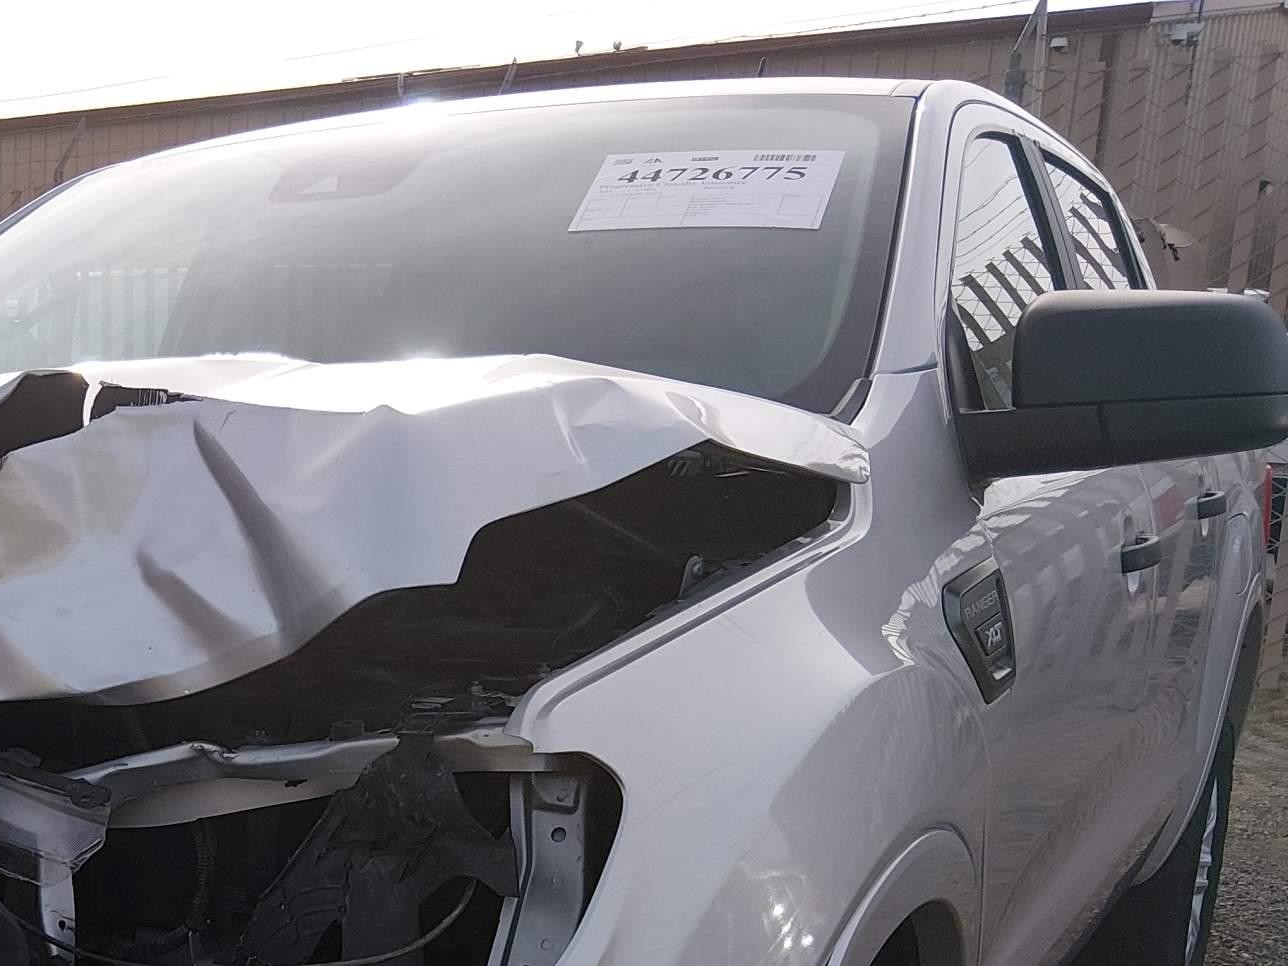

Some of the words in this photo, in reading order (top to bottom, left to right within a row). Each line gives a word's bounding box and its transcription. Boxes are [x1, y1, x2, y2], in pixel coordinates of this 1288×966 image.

[616, 166, 808, 183] 44726775
[964, 590, 999, 621] RANGER
[985, 622, 1002, 647] XLT
